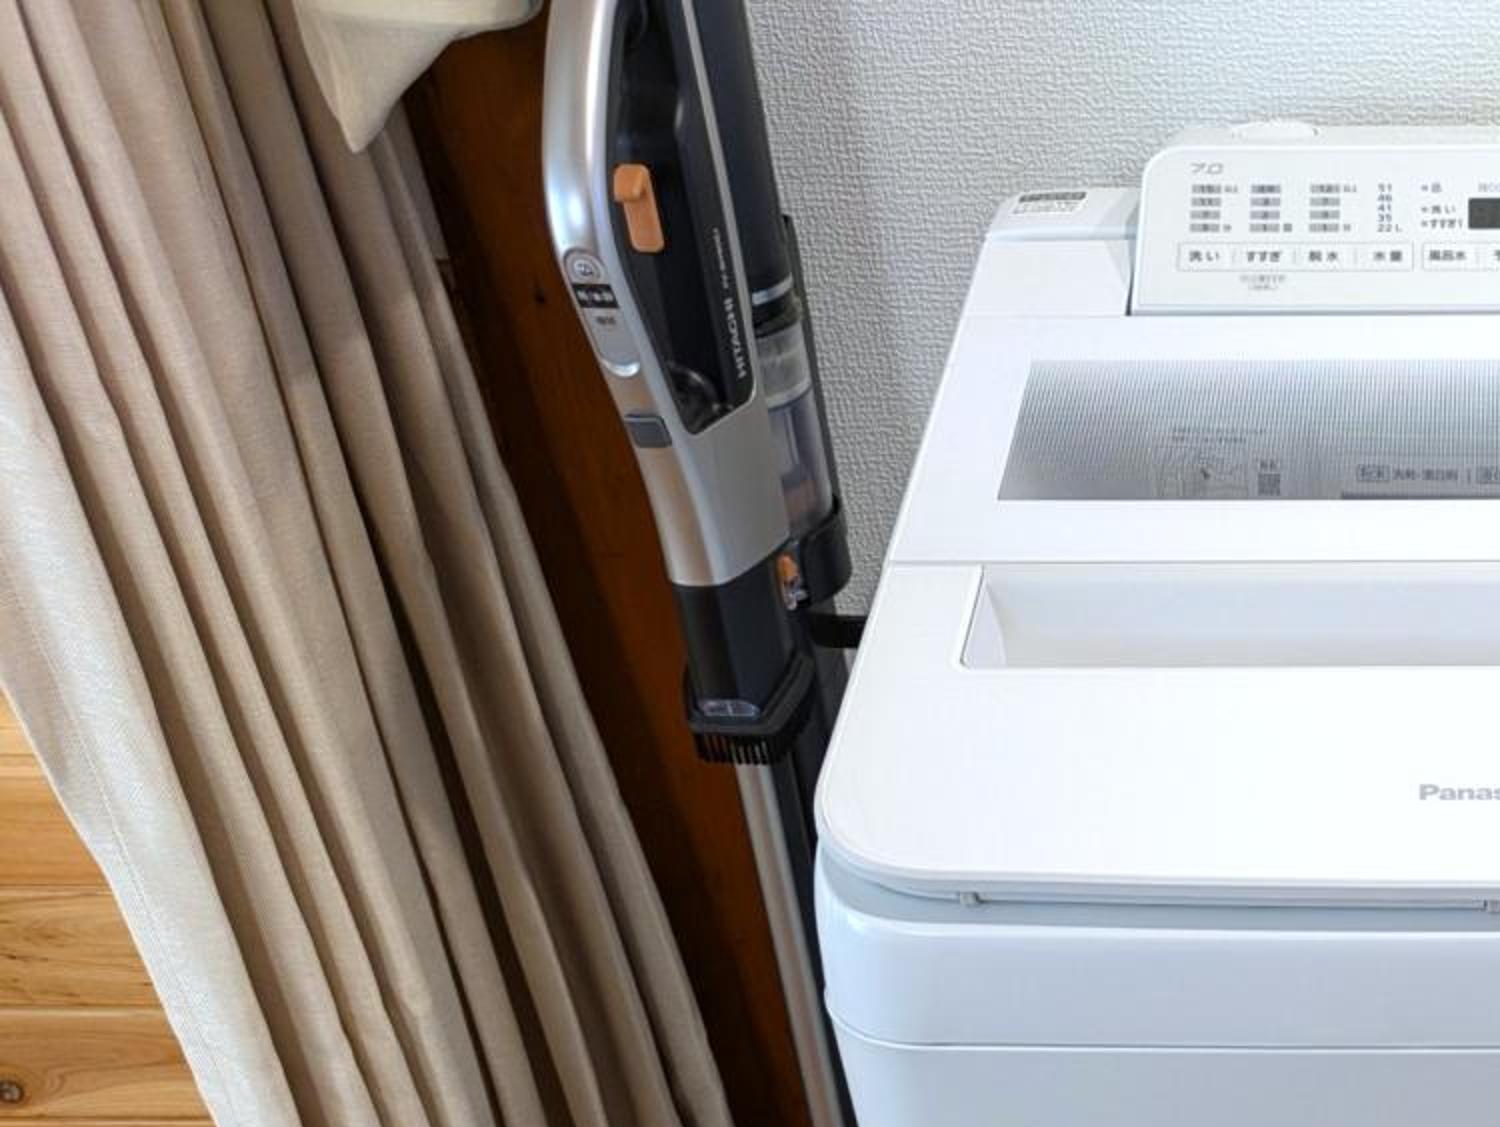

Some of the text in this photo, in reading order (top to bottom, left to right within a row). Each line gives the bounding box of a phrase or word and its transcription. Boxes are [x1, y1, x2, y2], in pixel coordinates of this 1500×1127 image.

[1189, 251, 1219, 262] 洗い
[1247, 251, 1283, 262] すすぎ
[1308, 251, 1339, 262] 脱水
[1373, 250, 1403, 262] 水量
[1429, 250, 1466, 261] 風呂水
